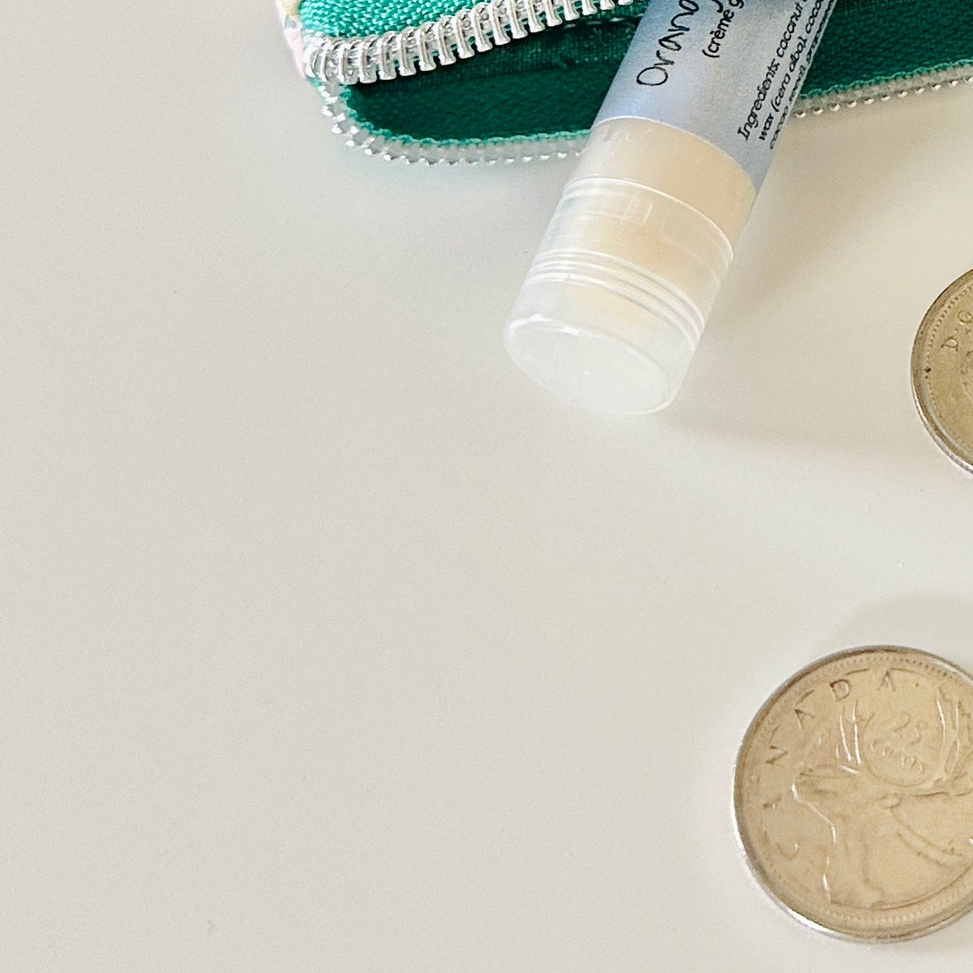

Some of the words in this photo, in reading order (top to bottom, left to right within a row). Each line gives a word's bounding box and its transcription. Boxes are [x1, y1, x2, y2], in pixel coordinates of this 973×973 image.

[702, 9, 734, 58] (crème
[777, 2, 803, 58] coconut
[772, 72, 790, 113] (cera
